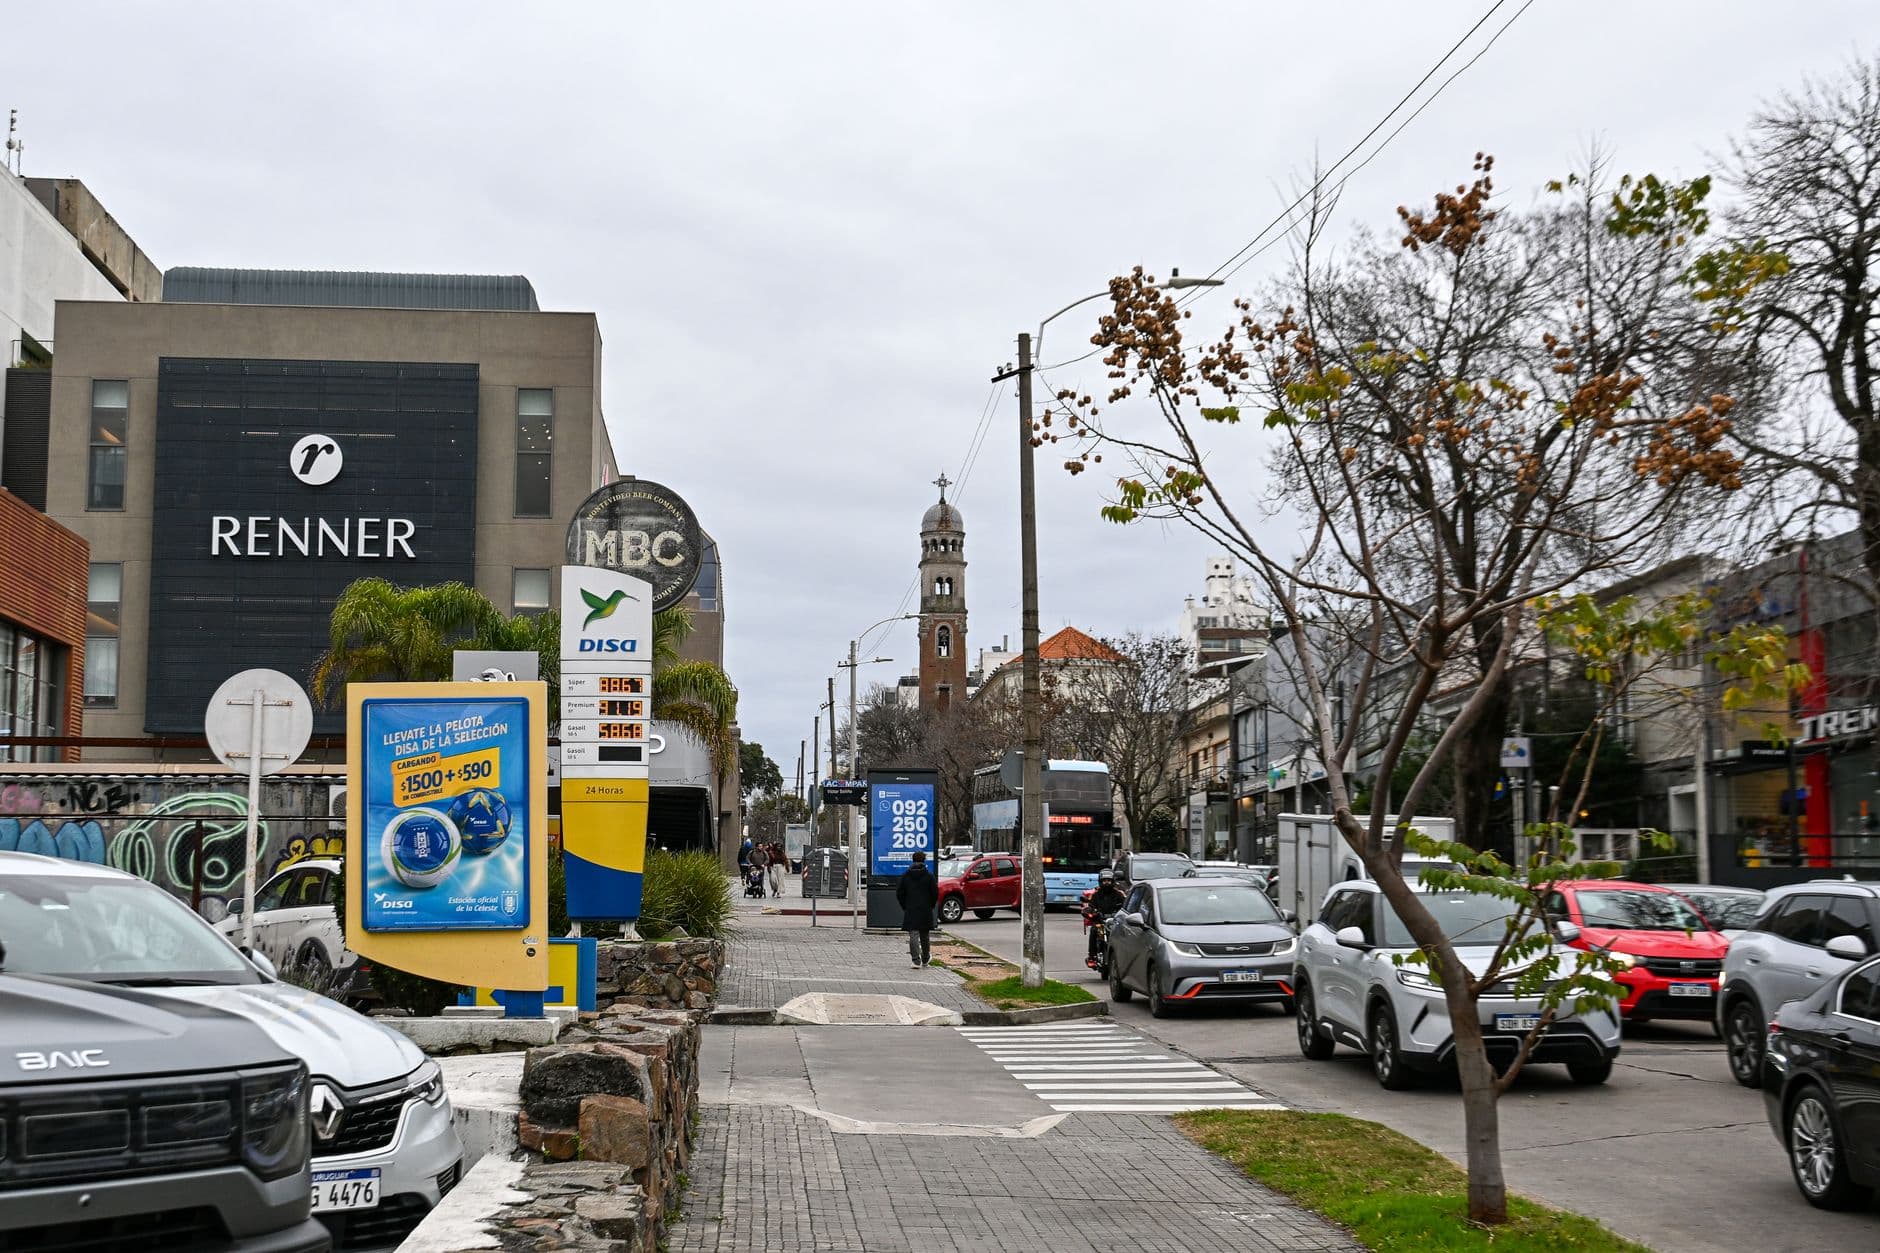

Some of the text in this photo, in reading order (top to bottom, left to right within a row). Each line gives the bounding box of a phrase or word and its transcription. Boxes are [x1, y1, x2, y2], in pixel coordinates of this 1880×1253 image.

[586, 491, 685, 522] MONTEVIDEO BEER COMPANY
[211, 516, 417, 558] RENNER
[584, 530, 685, 567] MBC
[653, 575, 684, 602] COMPANY
[579, 639, 637, 653] DISA
[383, 715, 484, 746] LLEVATE LA PELOTA
[1796, 707, 1880, 743] TREK
[395, 722, 508, 756] DISA DE LA SELECCIÓN
[396, 755, 437, 770] CARGANDO
[585, 786, 624, 794] 24 Horas
[892, 799, 928, 816] 092
[892, 816, 928, 832] 250
[892, 832, 928, 849] 260
[382, 900, 413, 909] DISA
[16, 1048, 110, 1070] BAIC
[312, 1170, 350, 1181] URUGUAY
[328, 1181, 374, 1207] 4476
